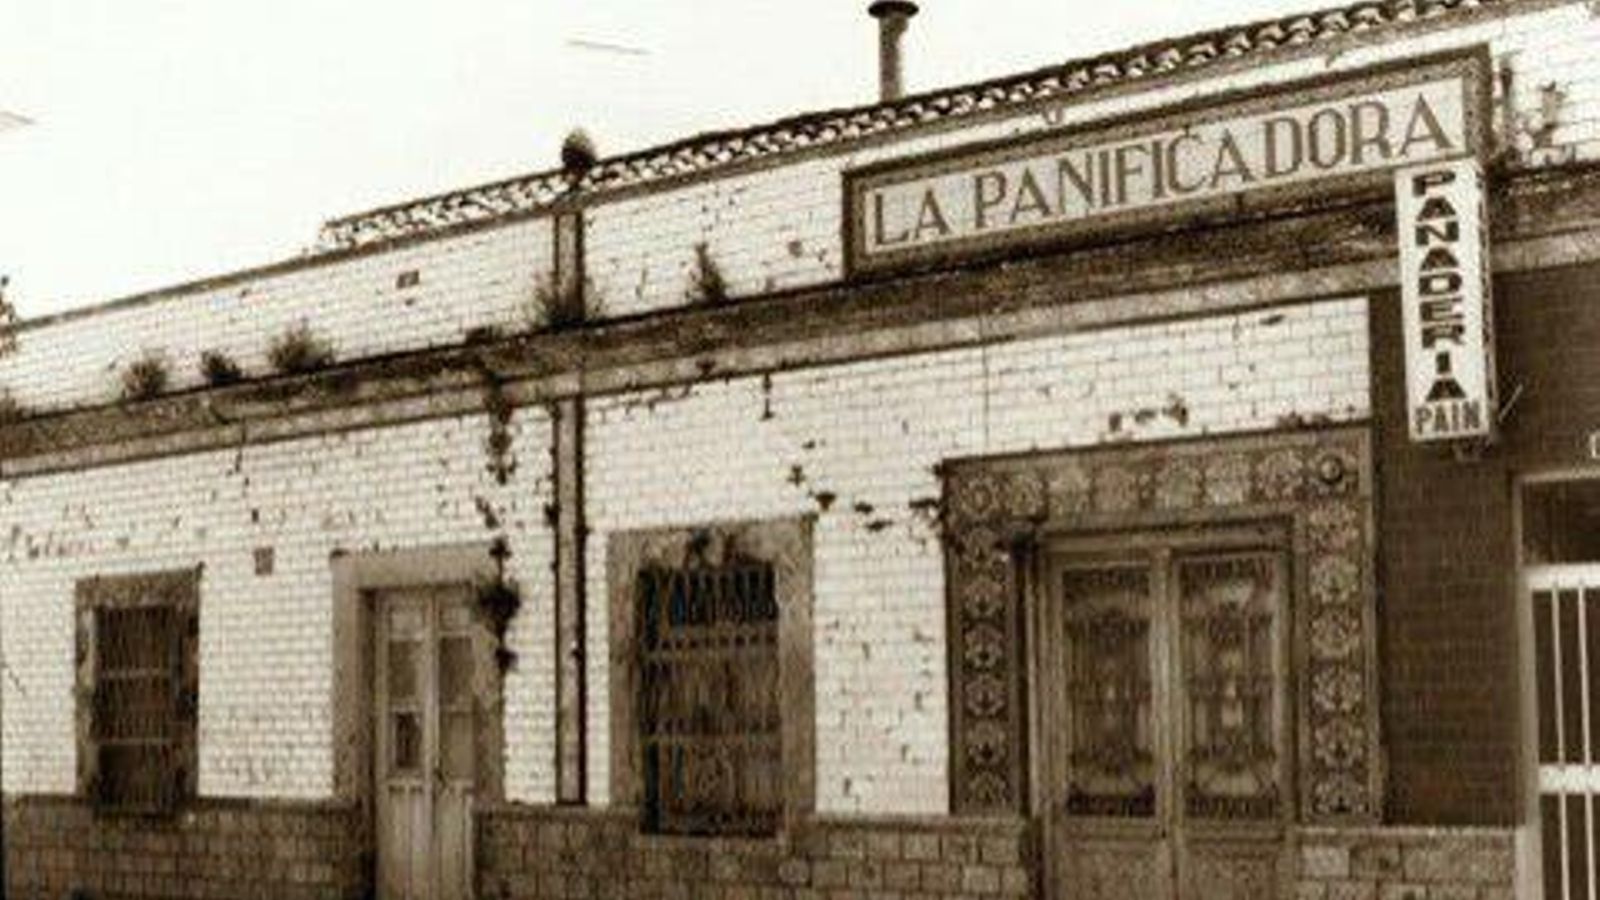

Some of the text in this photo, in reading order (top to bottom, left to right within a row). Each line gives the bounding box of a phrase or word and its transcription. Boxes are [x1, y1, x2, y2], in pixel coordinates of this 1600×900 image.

[873, 94, 1454, 246] LA PANIFICADORA
[1412, 171, 1467, 401] PANADERIA
[1414, 401, 1481, 435] PAIN
